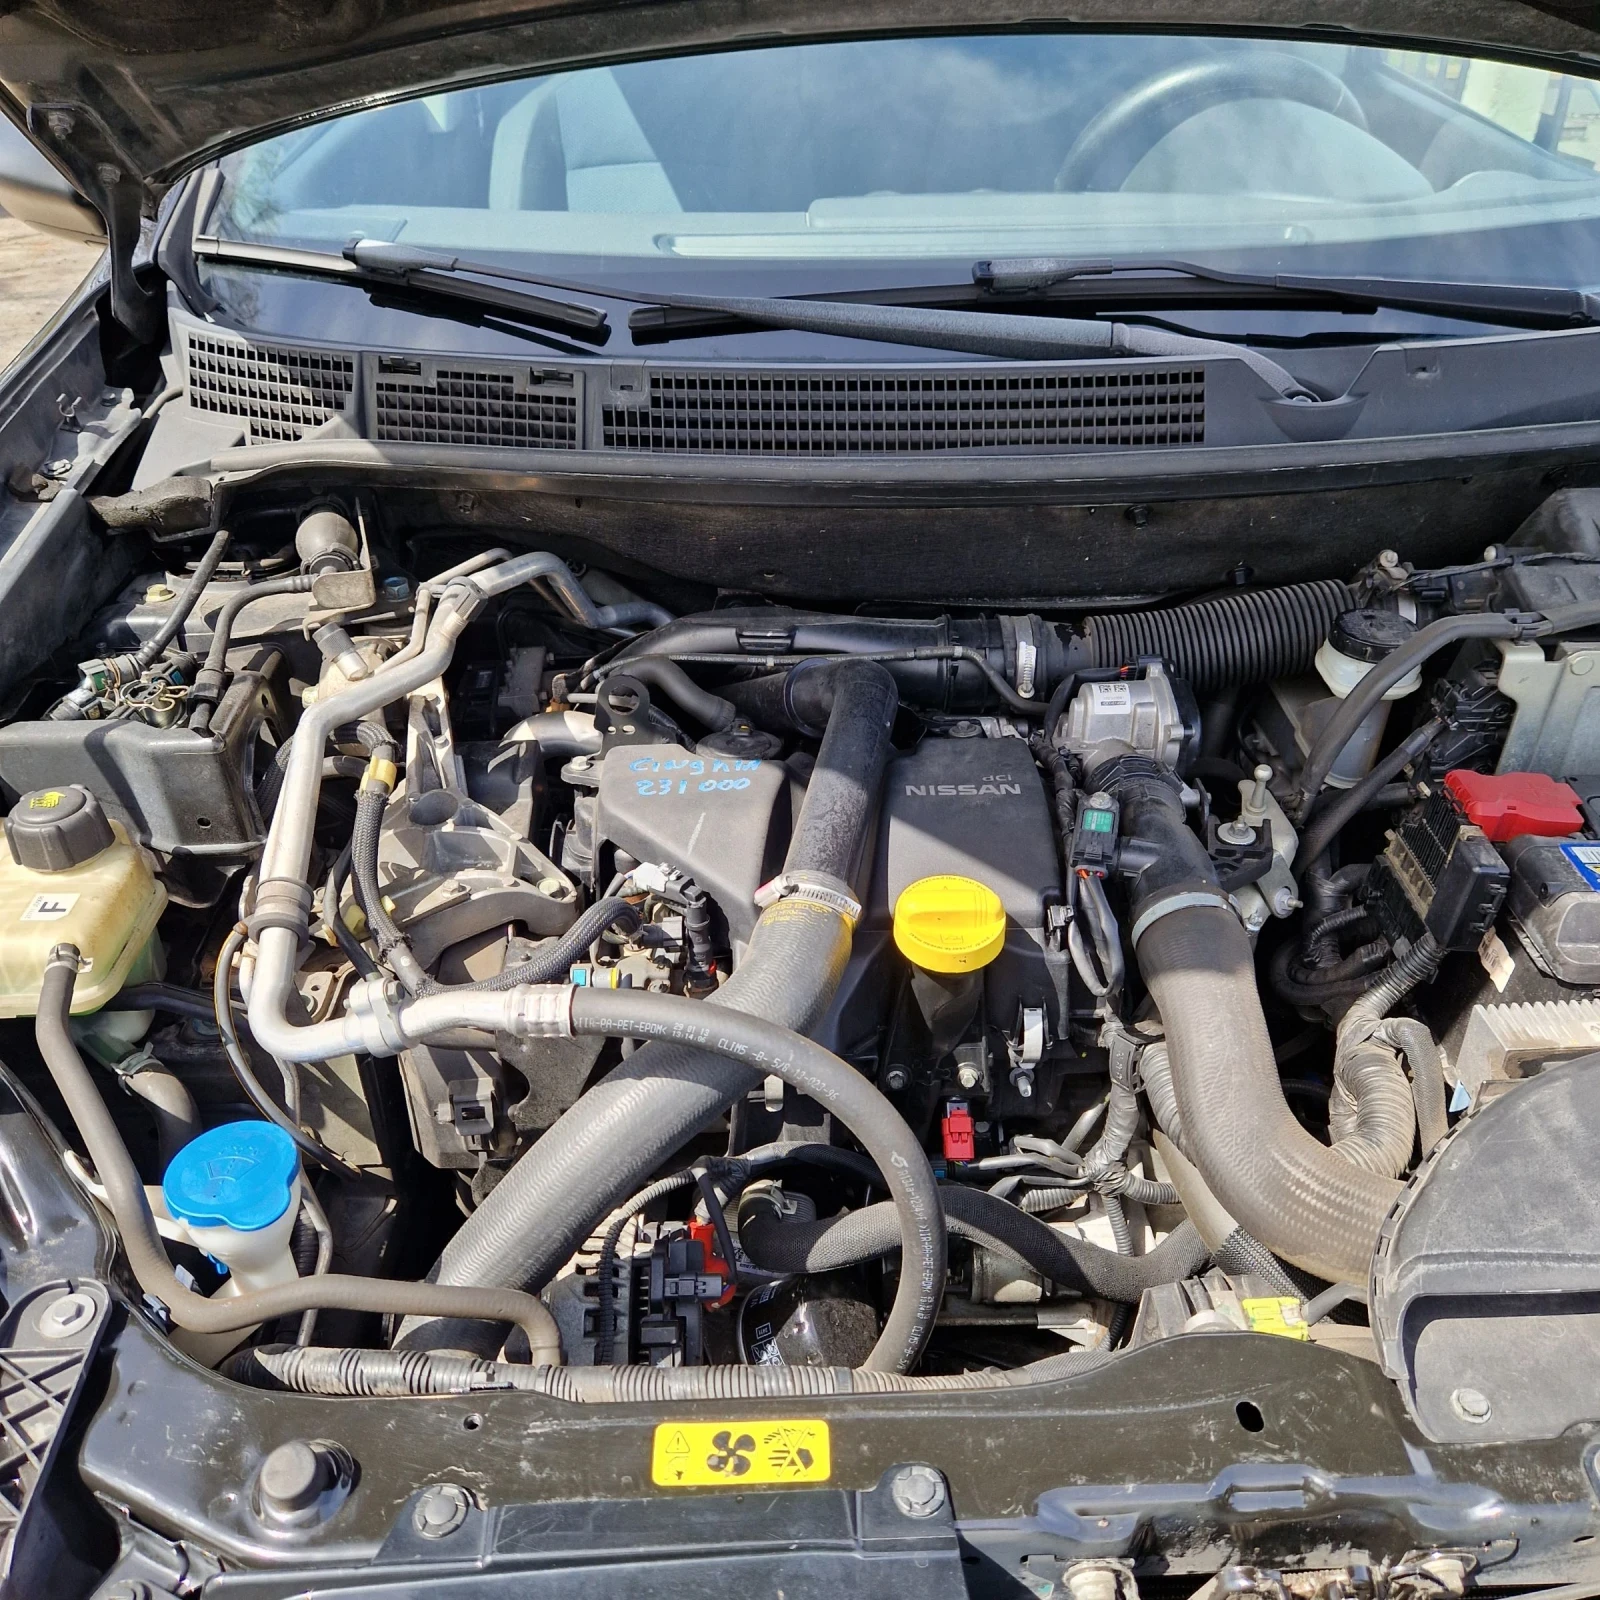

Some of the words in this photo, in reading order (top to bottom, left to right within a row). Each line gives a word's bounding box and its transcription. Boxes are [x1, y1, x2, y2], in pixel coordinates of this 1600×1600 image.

[636, 779, 688, 796] 231
[698, 777, 751, 792] 000
[905, 783, 1021, 796] NISSAN
[38, 901, 67, 912] F
